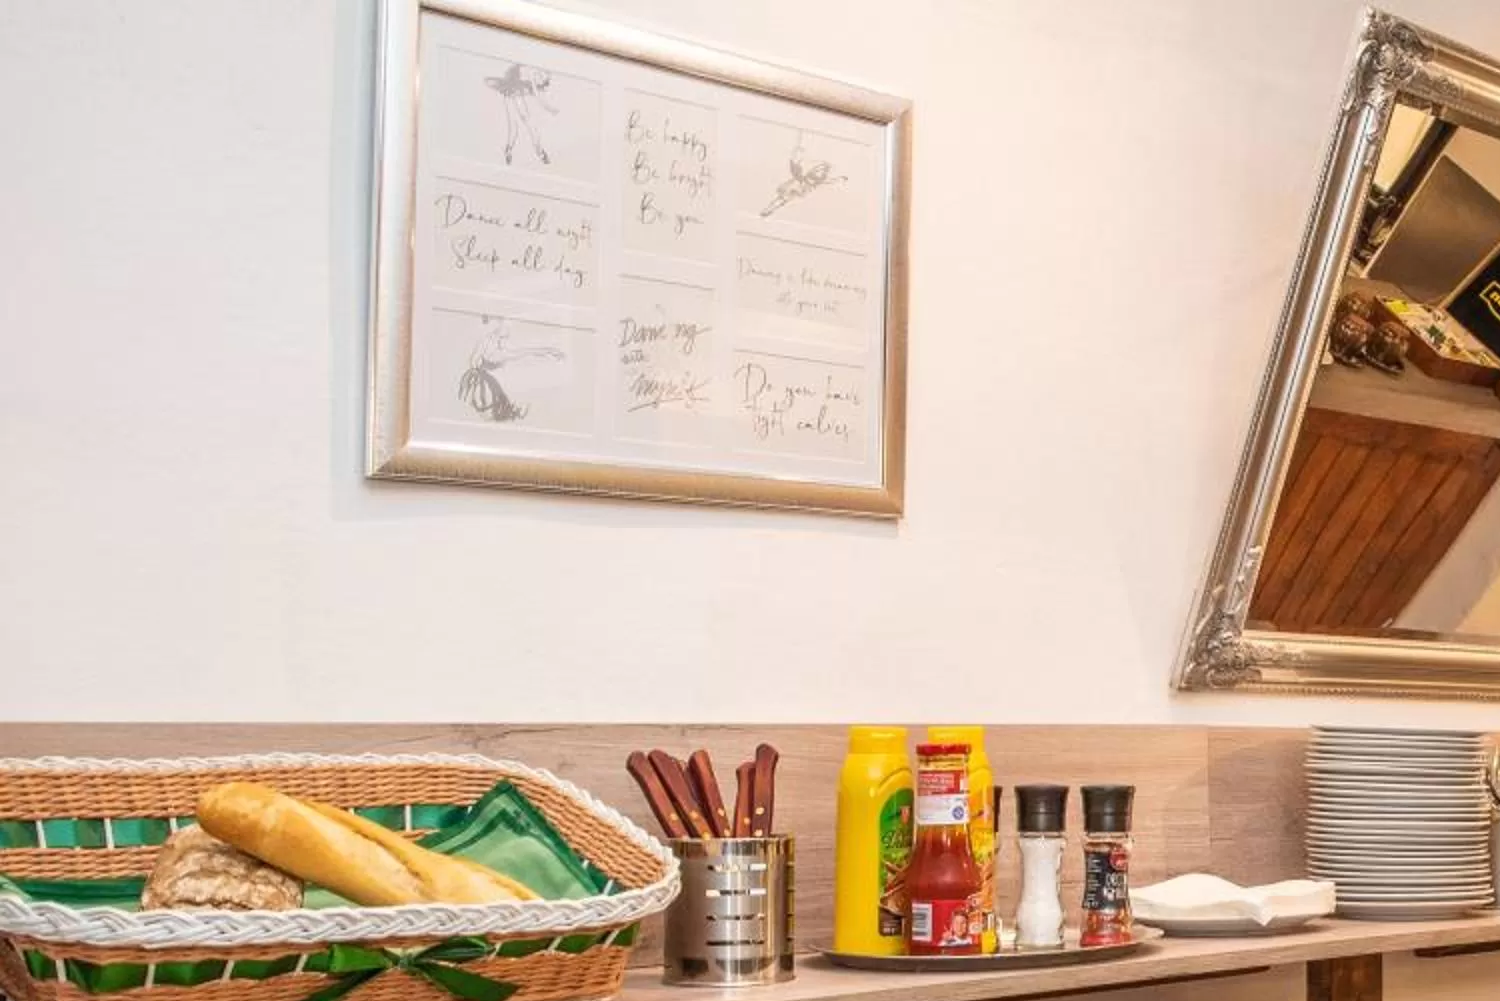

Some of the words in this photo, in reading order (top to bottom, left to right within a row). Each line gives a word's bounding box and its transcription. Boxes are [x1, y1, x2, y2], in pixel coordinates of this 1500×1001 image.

[624, 109, 653, 144] Be
[632, 150, 660, 185] Be
[434, 194, 505, 228] Dance
[513, 207, 547, 234] all
[511, 244, 545, 271] all
